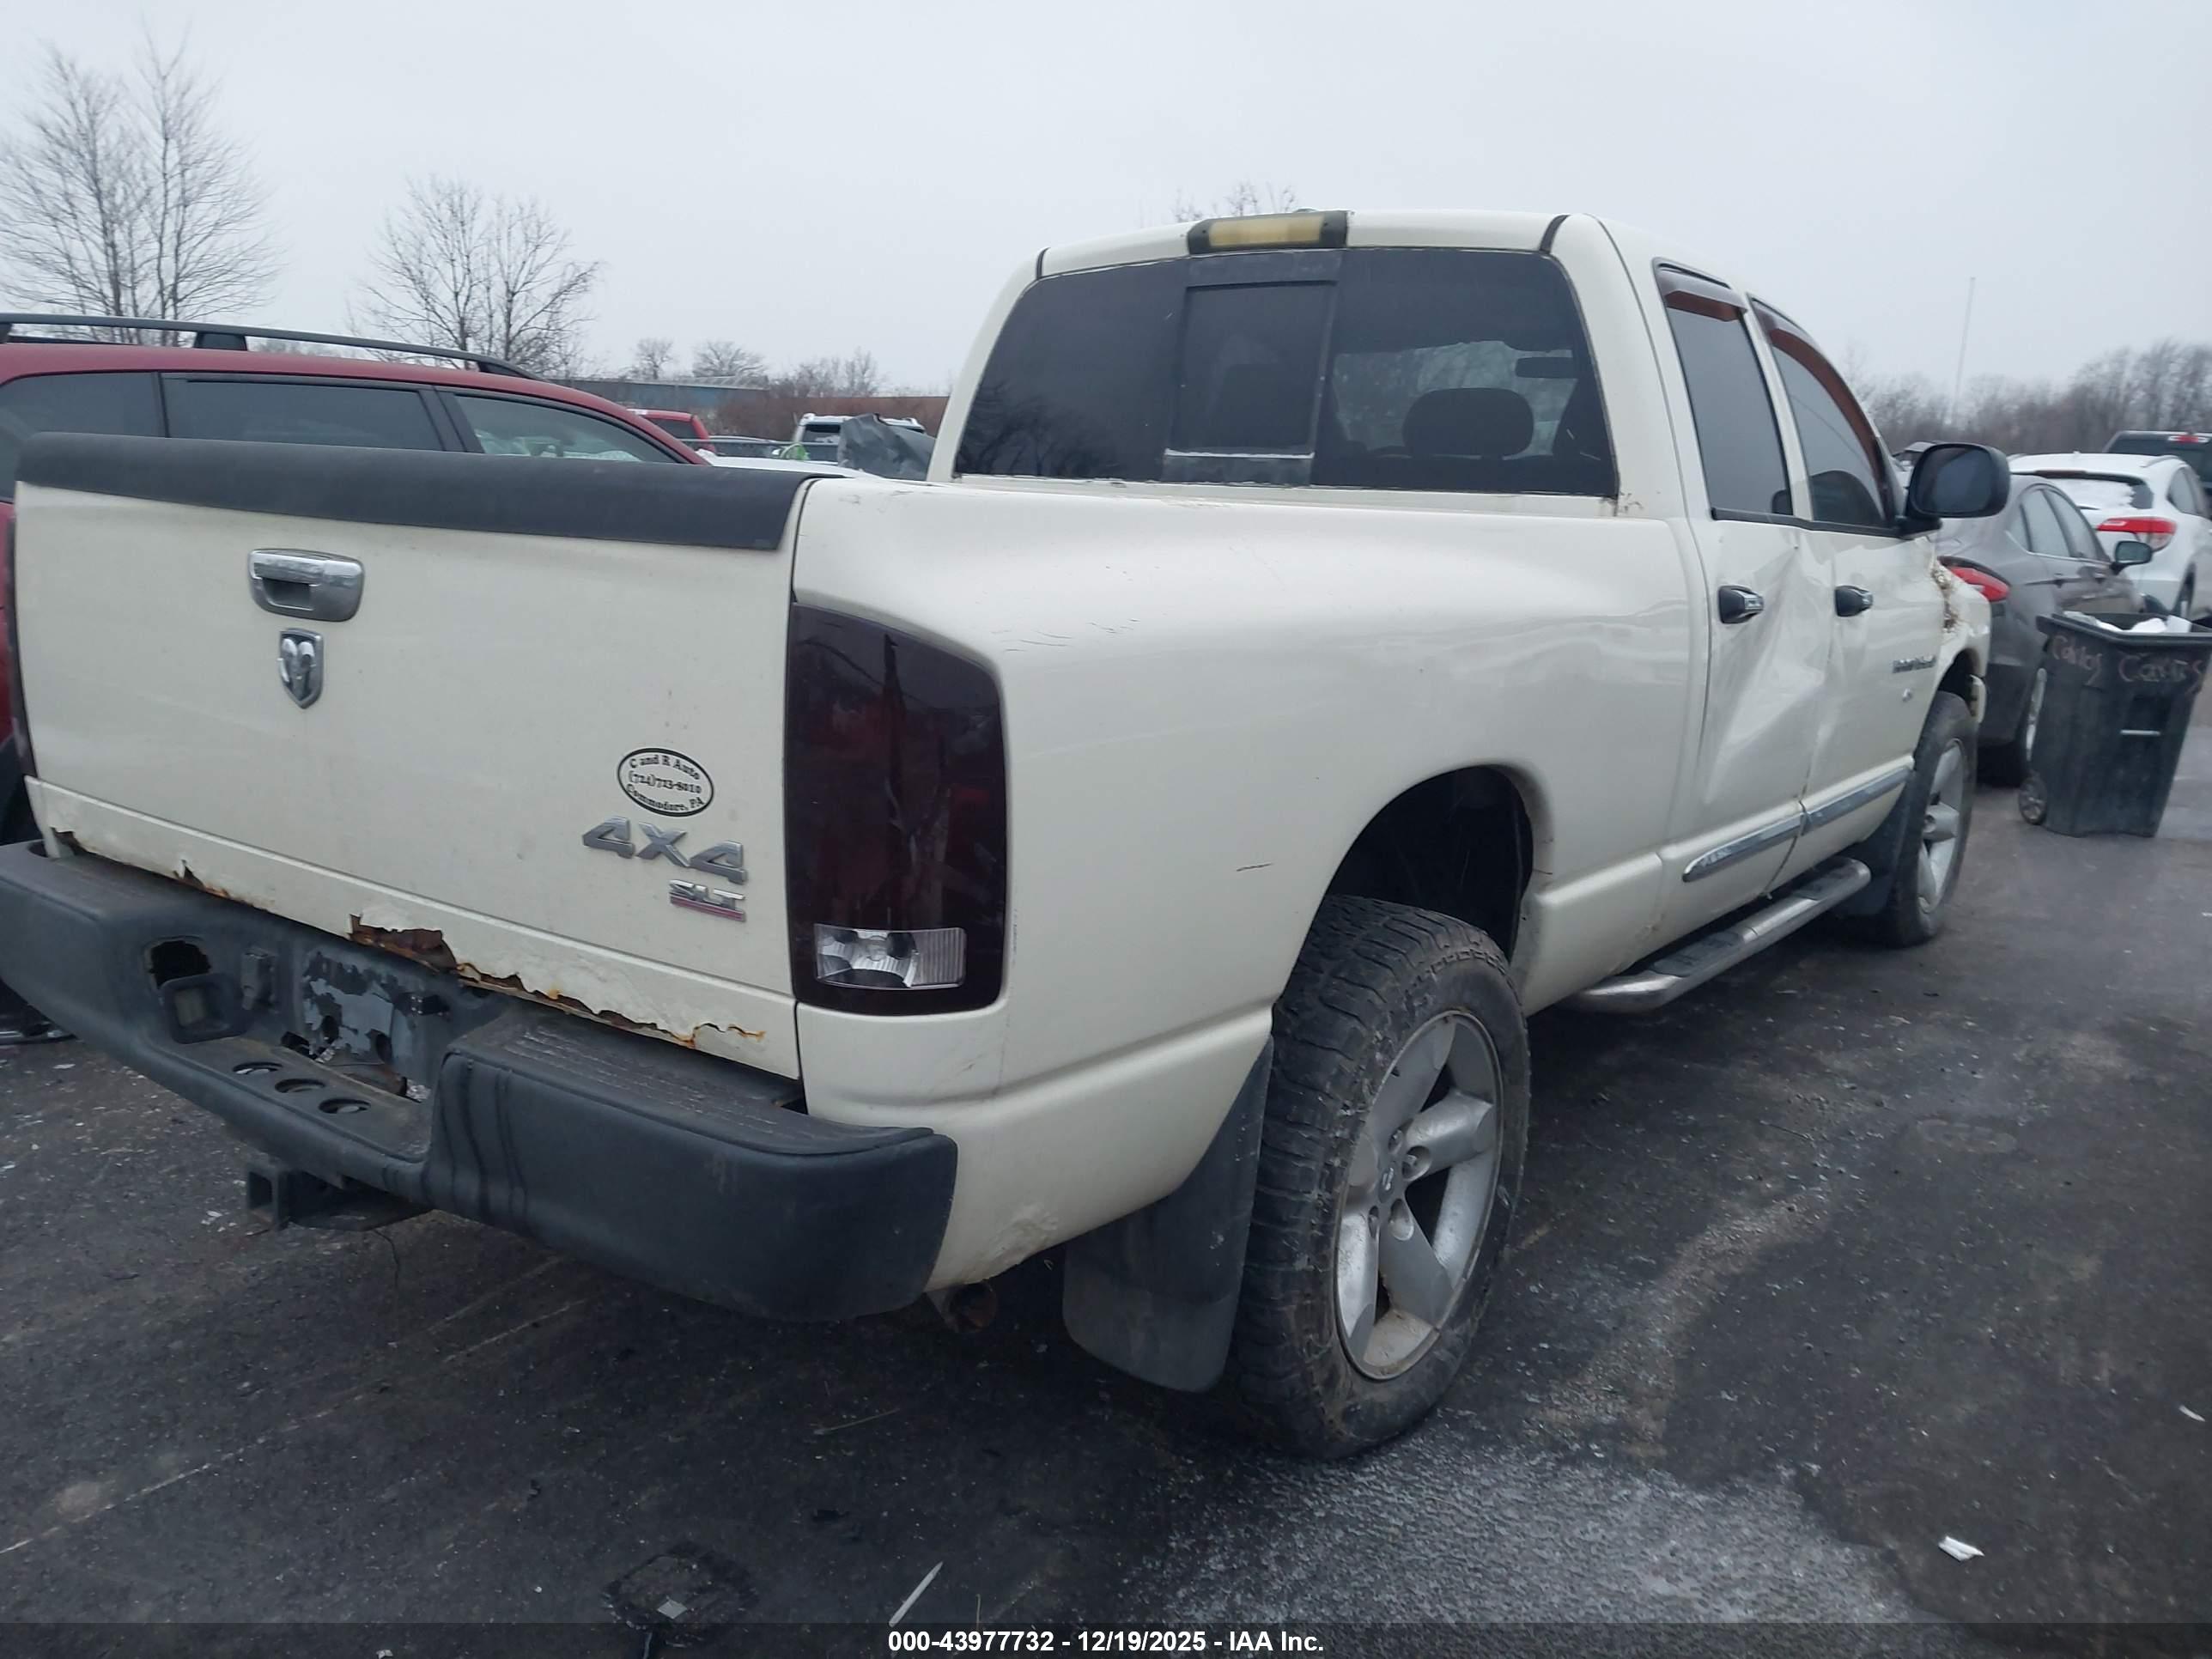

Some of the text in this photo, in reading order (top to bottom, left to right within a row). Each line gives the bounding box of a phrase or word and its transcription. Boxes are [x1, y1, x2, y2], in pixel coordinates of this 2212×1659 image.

[629, 755, 700, 780] C and R Auto
[690, 797, 705, 808] PA
[669, 879, 745, 915] SLT
